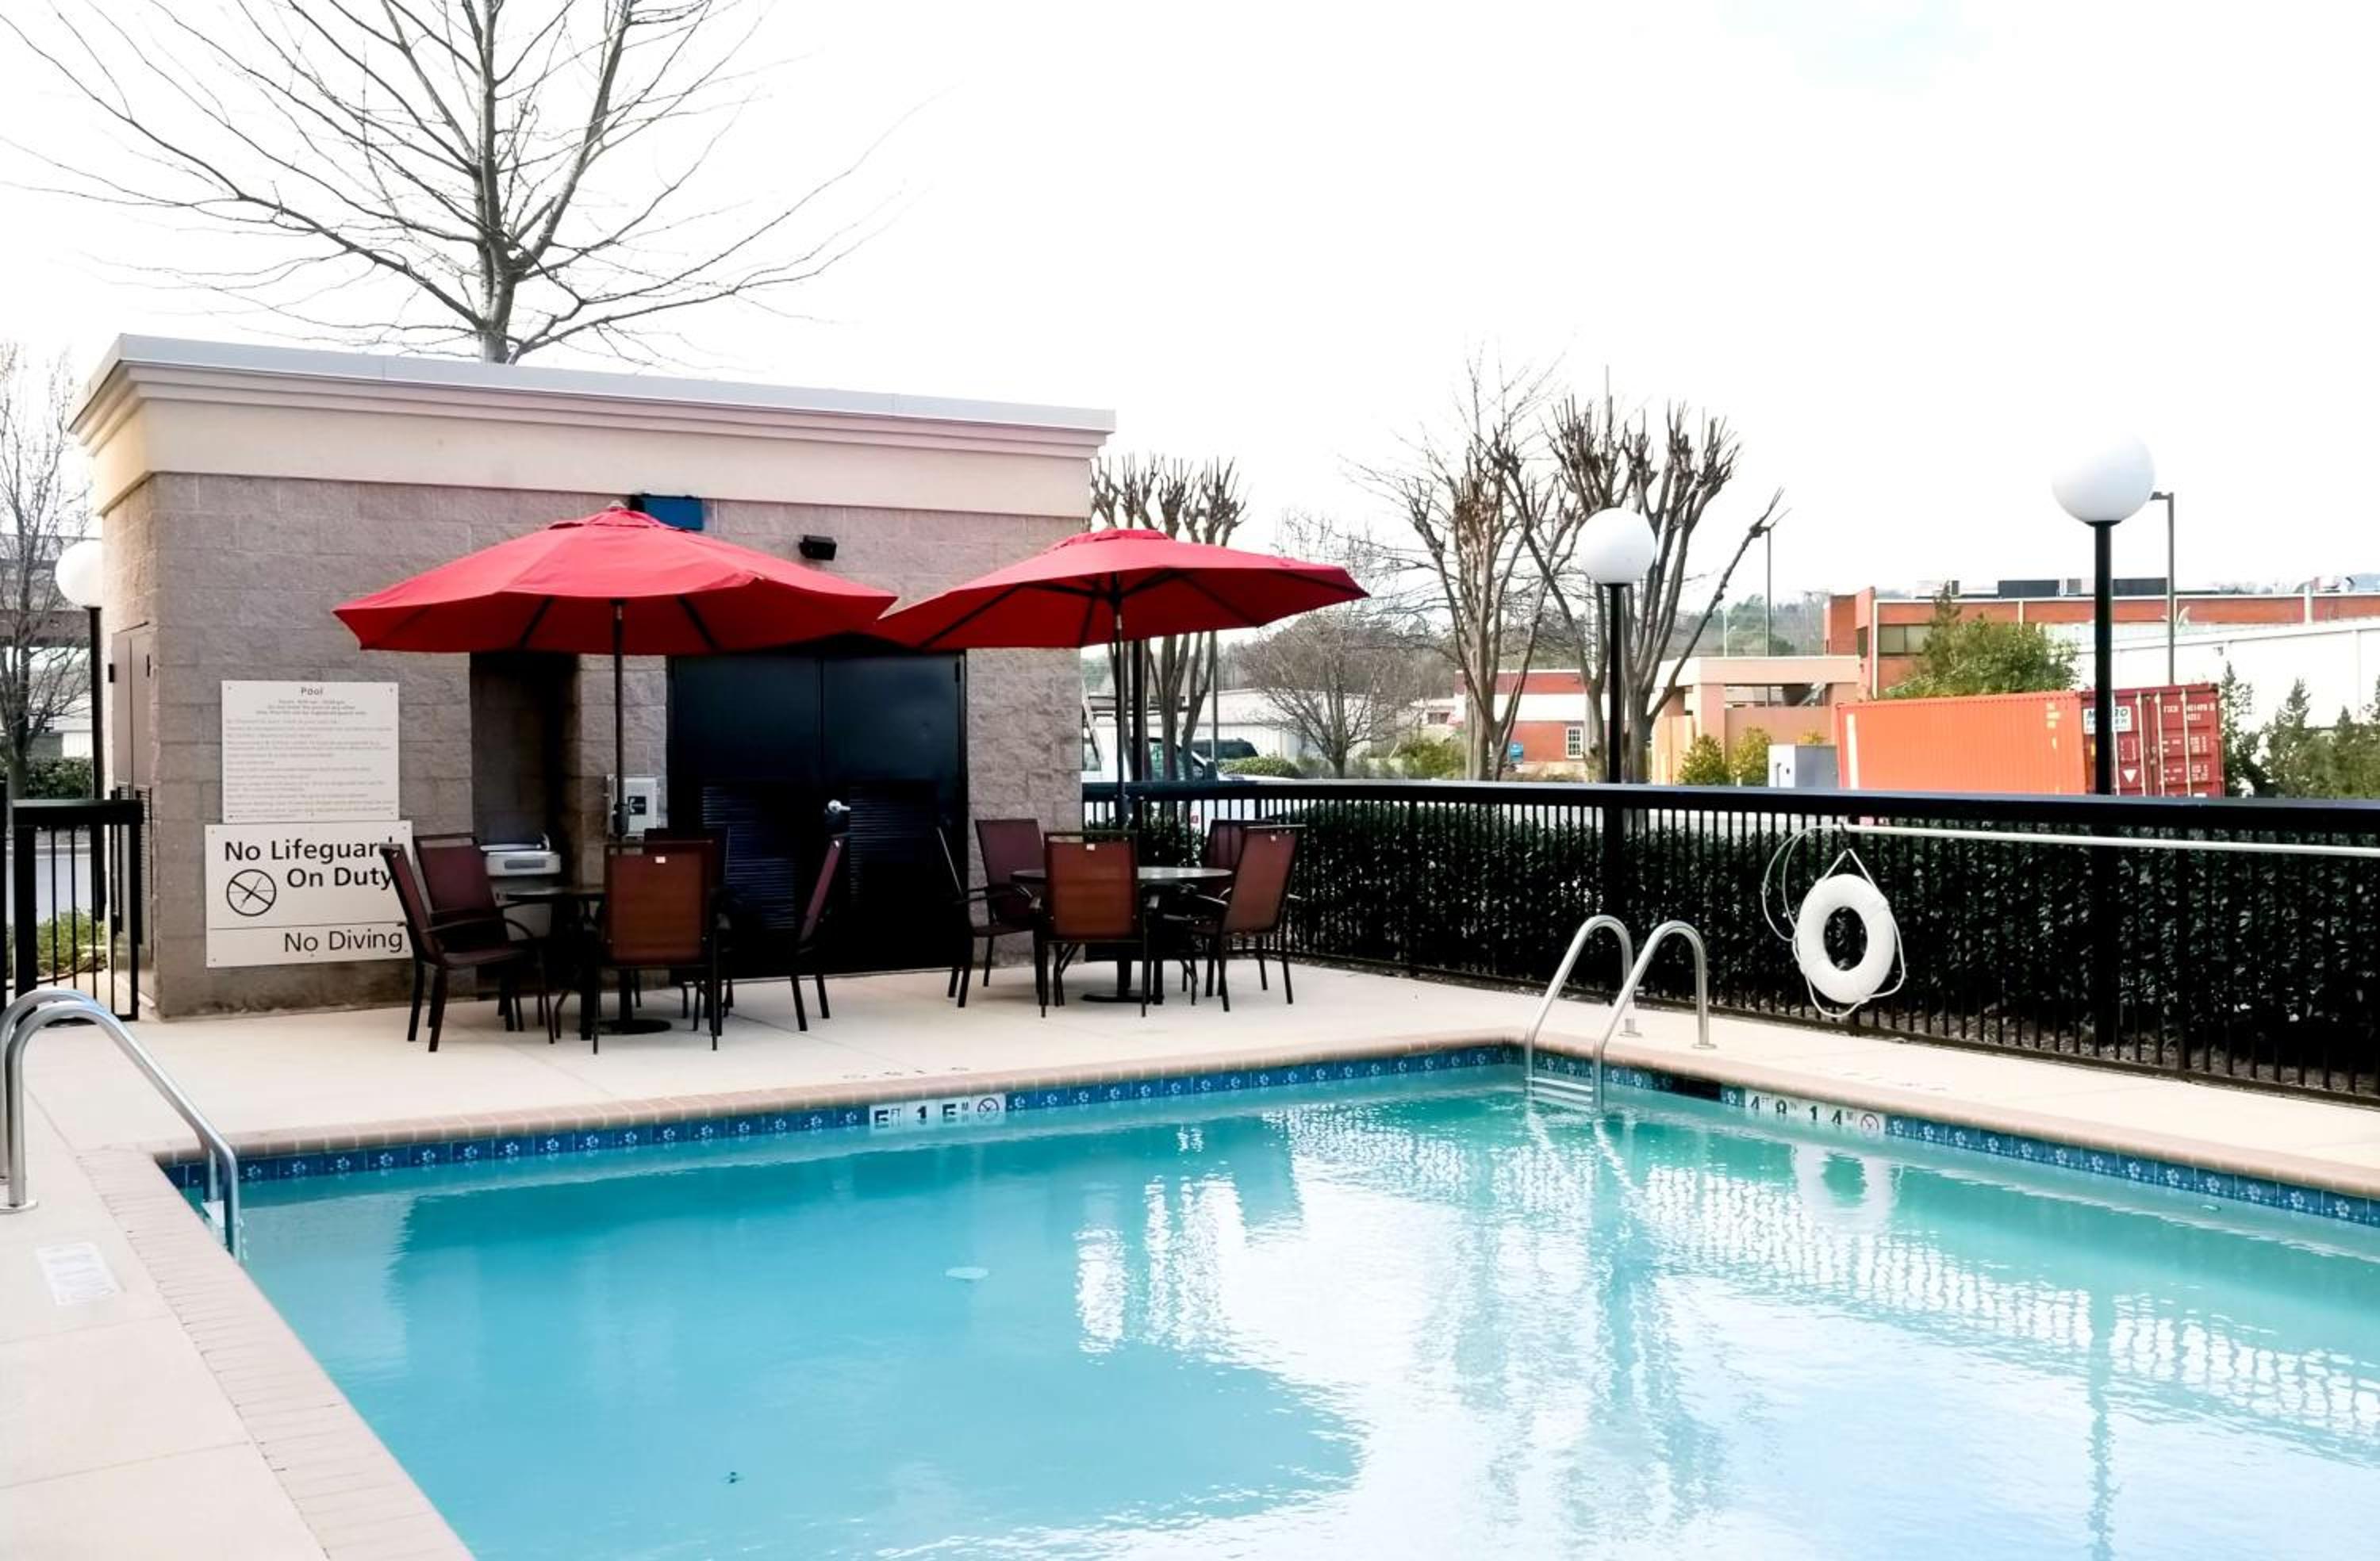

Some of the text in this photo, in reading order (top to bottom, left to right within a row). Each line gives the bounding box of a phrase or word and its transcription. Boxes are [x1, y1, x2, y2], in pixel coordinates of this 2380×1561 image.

[300, 687, 323, 696] Pool
[225, 836, 393, 865] No Lifeguar
[286, 866, 393, 891] On Duty
[285, 929, 403, 953] No Diving
